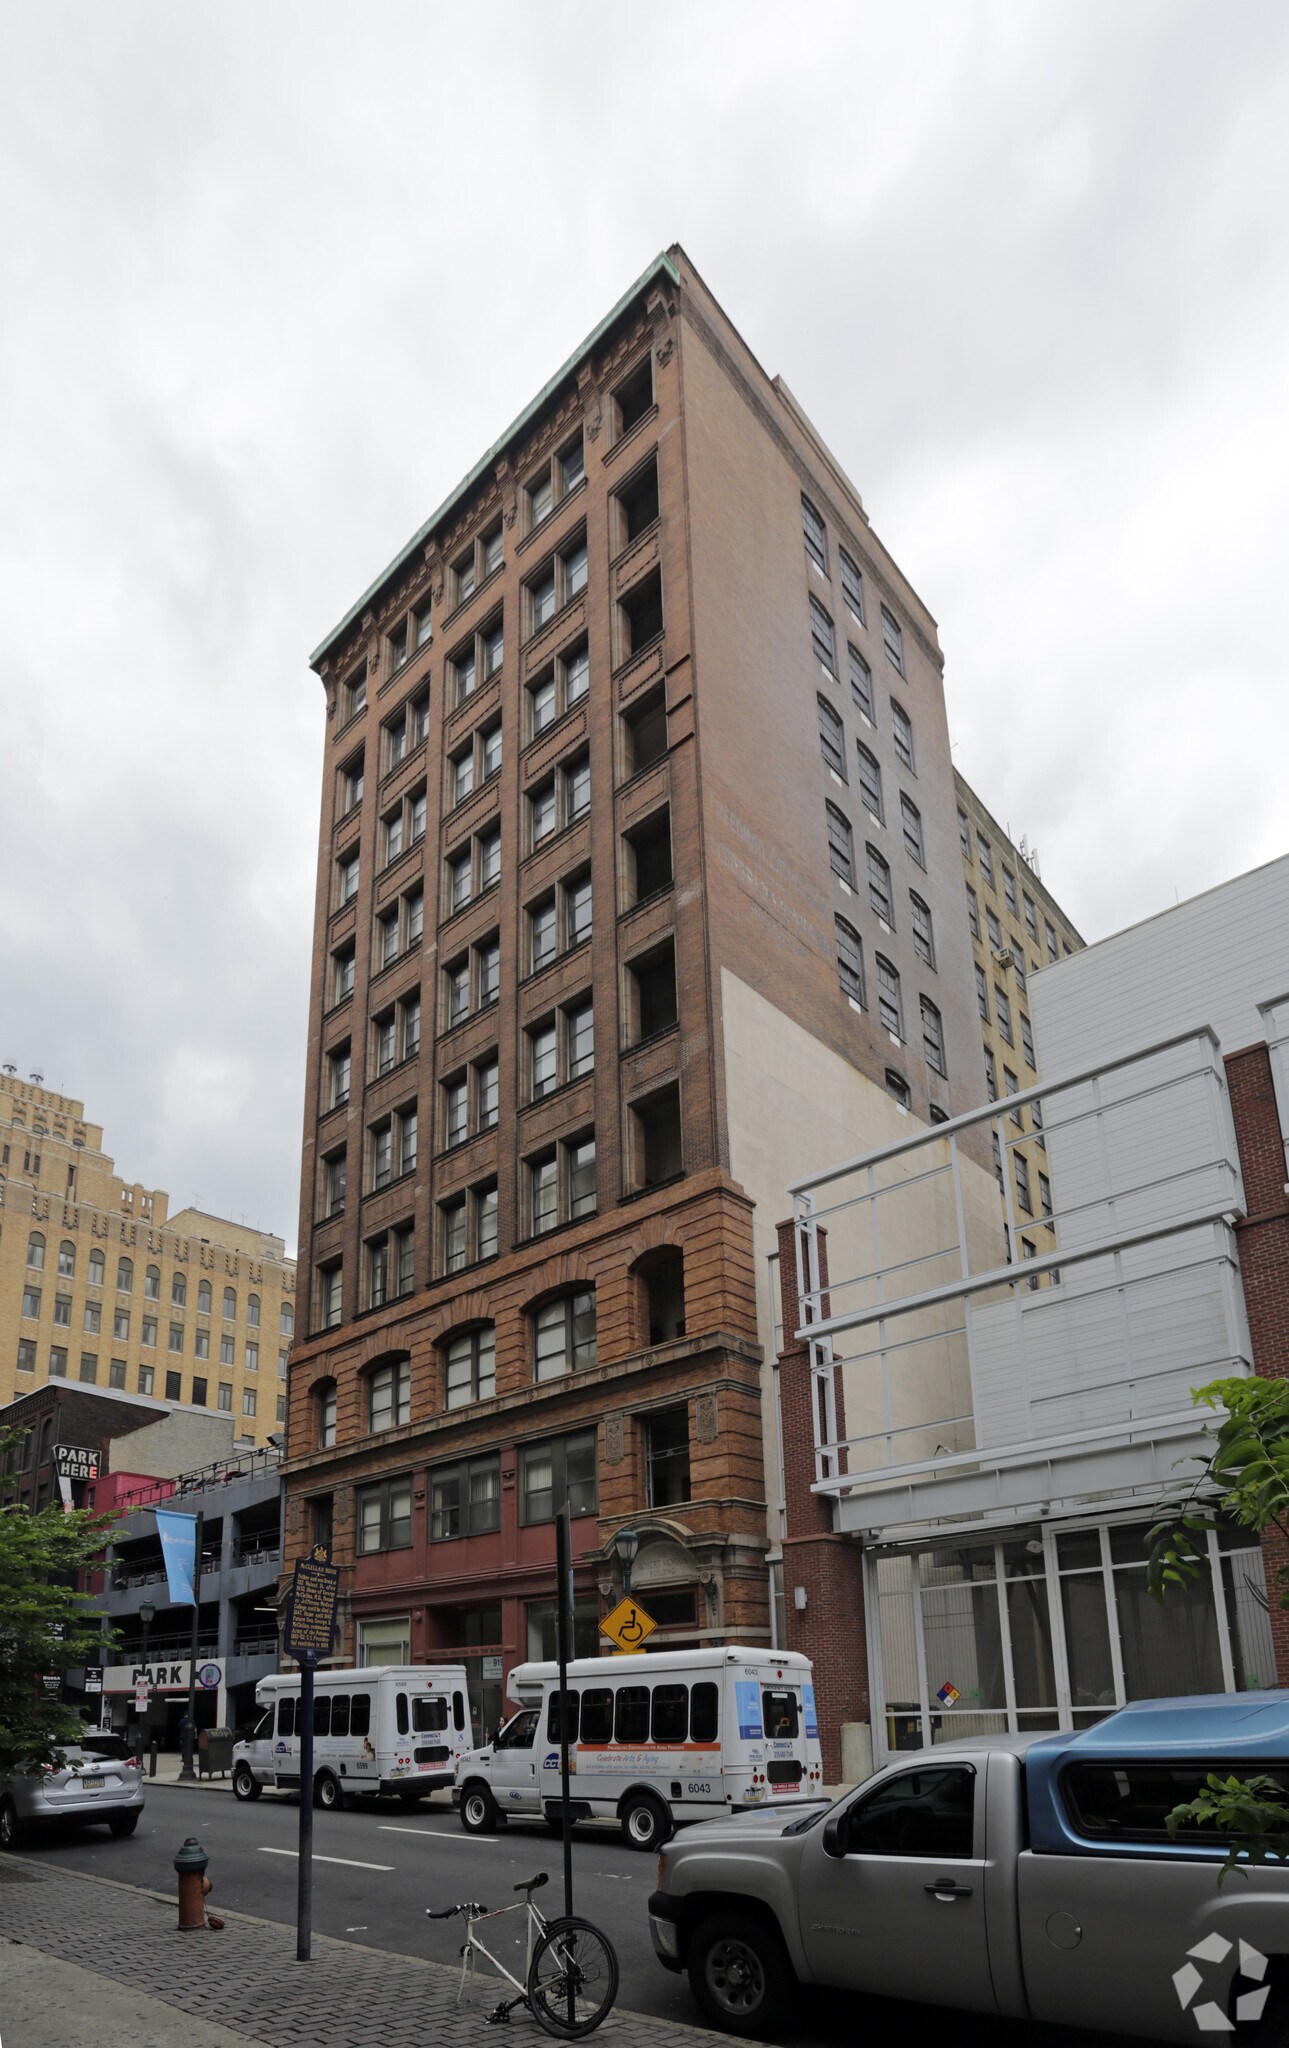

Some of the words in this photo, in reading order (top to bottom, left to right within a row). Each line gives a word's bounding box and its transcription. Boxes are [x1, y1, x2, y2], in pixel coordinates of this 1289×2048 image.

[58, 1447, 98, 1465] PARK
[61, 1462, 98, 1479] HERE
[650, 1568, 676, 1577] BUILDING
[132, 1666, 182, 1685] PARK
[745, 1668, 758, 1676] 6043
[596, 1753, 622, 1763] Celebrate
[622, 1754, 636, 1763] Arts
[636, 1754, 643, 1762] &
[643, 1755, 659, 1764] Aging
[356, 1762, 368, 1770] 6599
[688, 1784, 711, 1794] 6043
